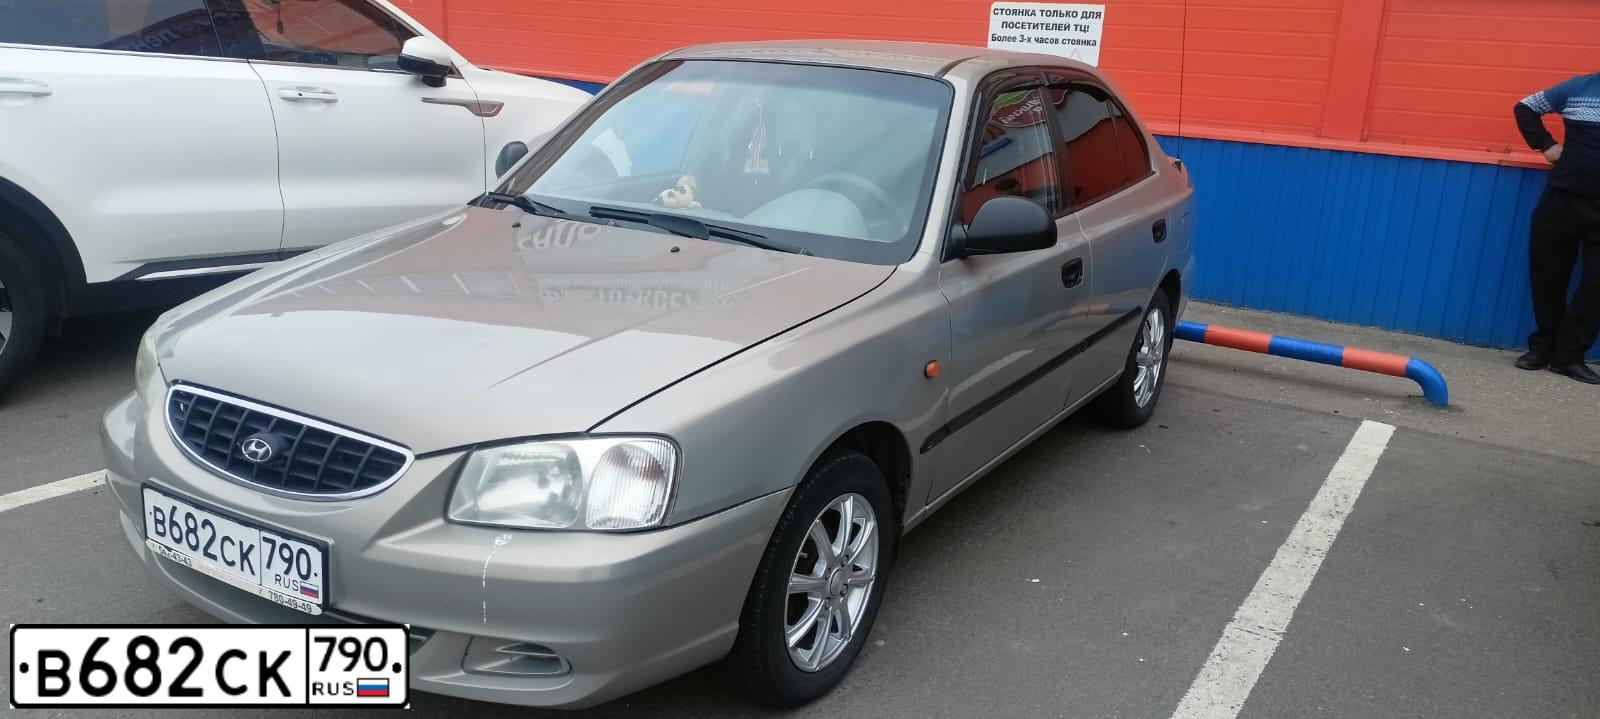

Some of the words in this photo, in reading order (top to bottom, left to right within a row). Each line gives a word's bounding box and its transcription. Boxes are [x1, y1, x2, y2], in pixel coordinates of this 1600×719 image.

[993, 8, 1037, 17] СТОЯНКА
[1040, 9, 1078, 19] ТОЛЬКО
[1080, 11, 1102, 20] ДЛЯ
[1001, 21, 1071, 32] ПОСЕТИТЕЛЕЙ
[1073, 24, 1090, 34] ТЦ!
[991, 33, 1017, 43] Более
[1019, 34, 1032, 43] 3-х
[1034, 36, 1059, 45] часов
[1061, 38, 1097, 47] стоянка
[262, 536, 312, 581] 790
[274, 574, 299, 592] RUS
